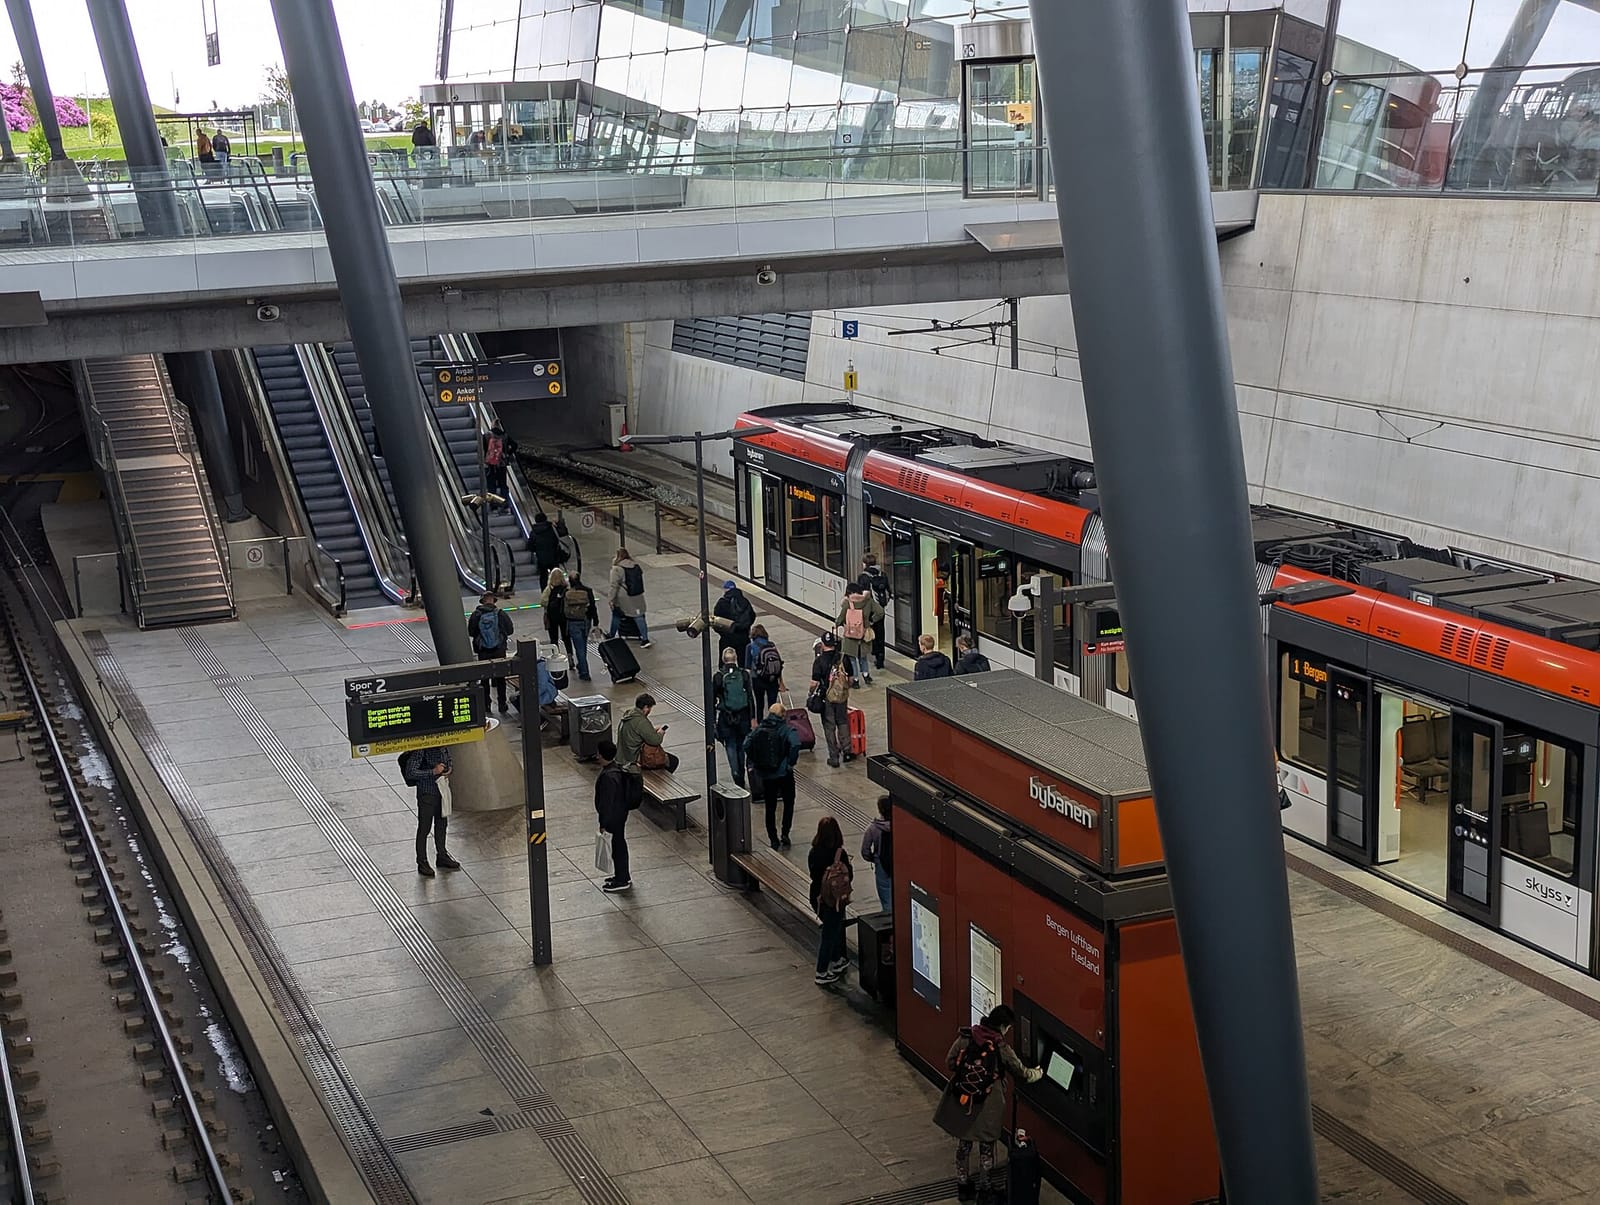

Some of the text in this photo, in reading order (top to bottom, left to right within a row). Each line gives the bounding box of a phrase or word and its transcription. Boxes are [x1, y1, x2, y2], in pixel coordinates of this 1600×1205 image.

[846, 323, 855, 335] S
[848, 374, 854, 389] 1
[1294, 659, 1328, 682] 1 Bergen
[349, 679, 387, 693] Spor 2
[1029, 775, 1093, 829] bybanen
[1525, 877, 1562, 902] skyss
[1045, 913, 1070, 938] Bergen
[1071, 947, 1100, 976] Flesland
